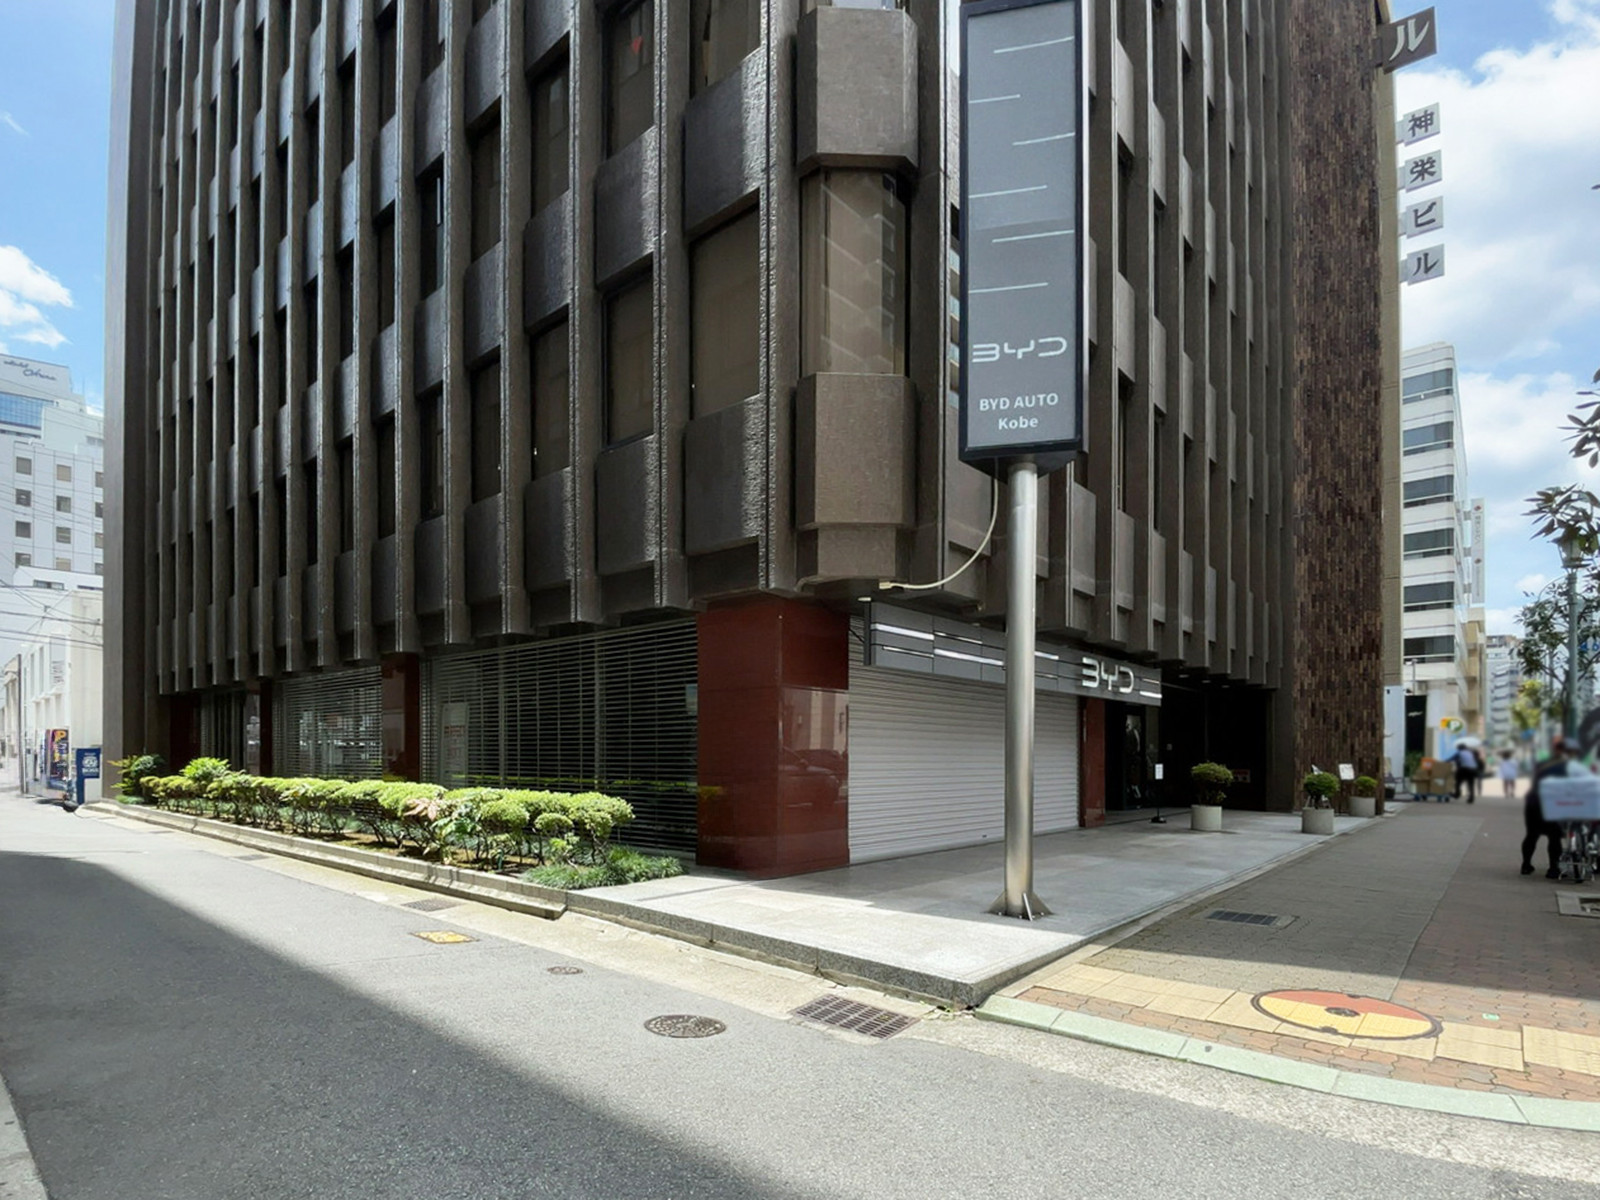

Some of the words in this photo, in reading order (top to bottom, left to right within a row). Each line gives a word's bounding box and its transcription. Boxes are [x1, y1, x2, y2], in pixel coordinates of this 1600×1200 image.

[1388, 18, 1430, 61] ル
[1407, 109, 1440, 276] 神栄ビル
[972, 336, 1067, 363] BYD
[979, 397, 1010, 411] BYD
[1013, 393, 1059, 409] AUTO
[998, 416, 1039, 430] Kobe
[1082, 657, 1134, 693] BYD
